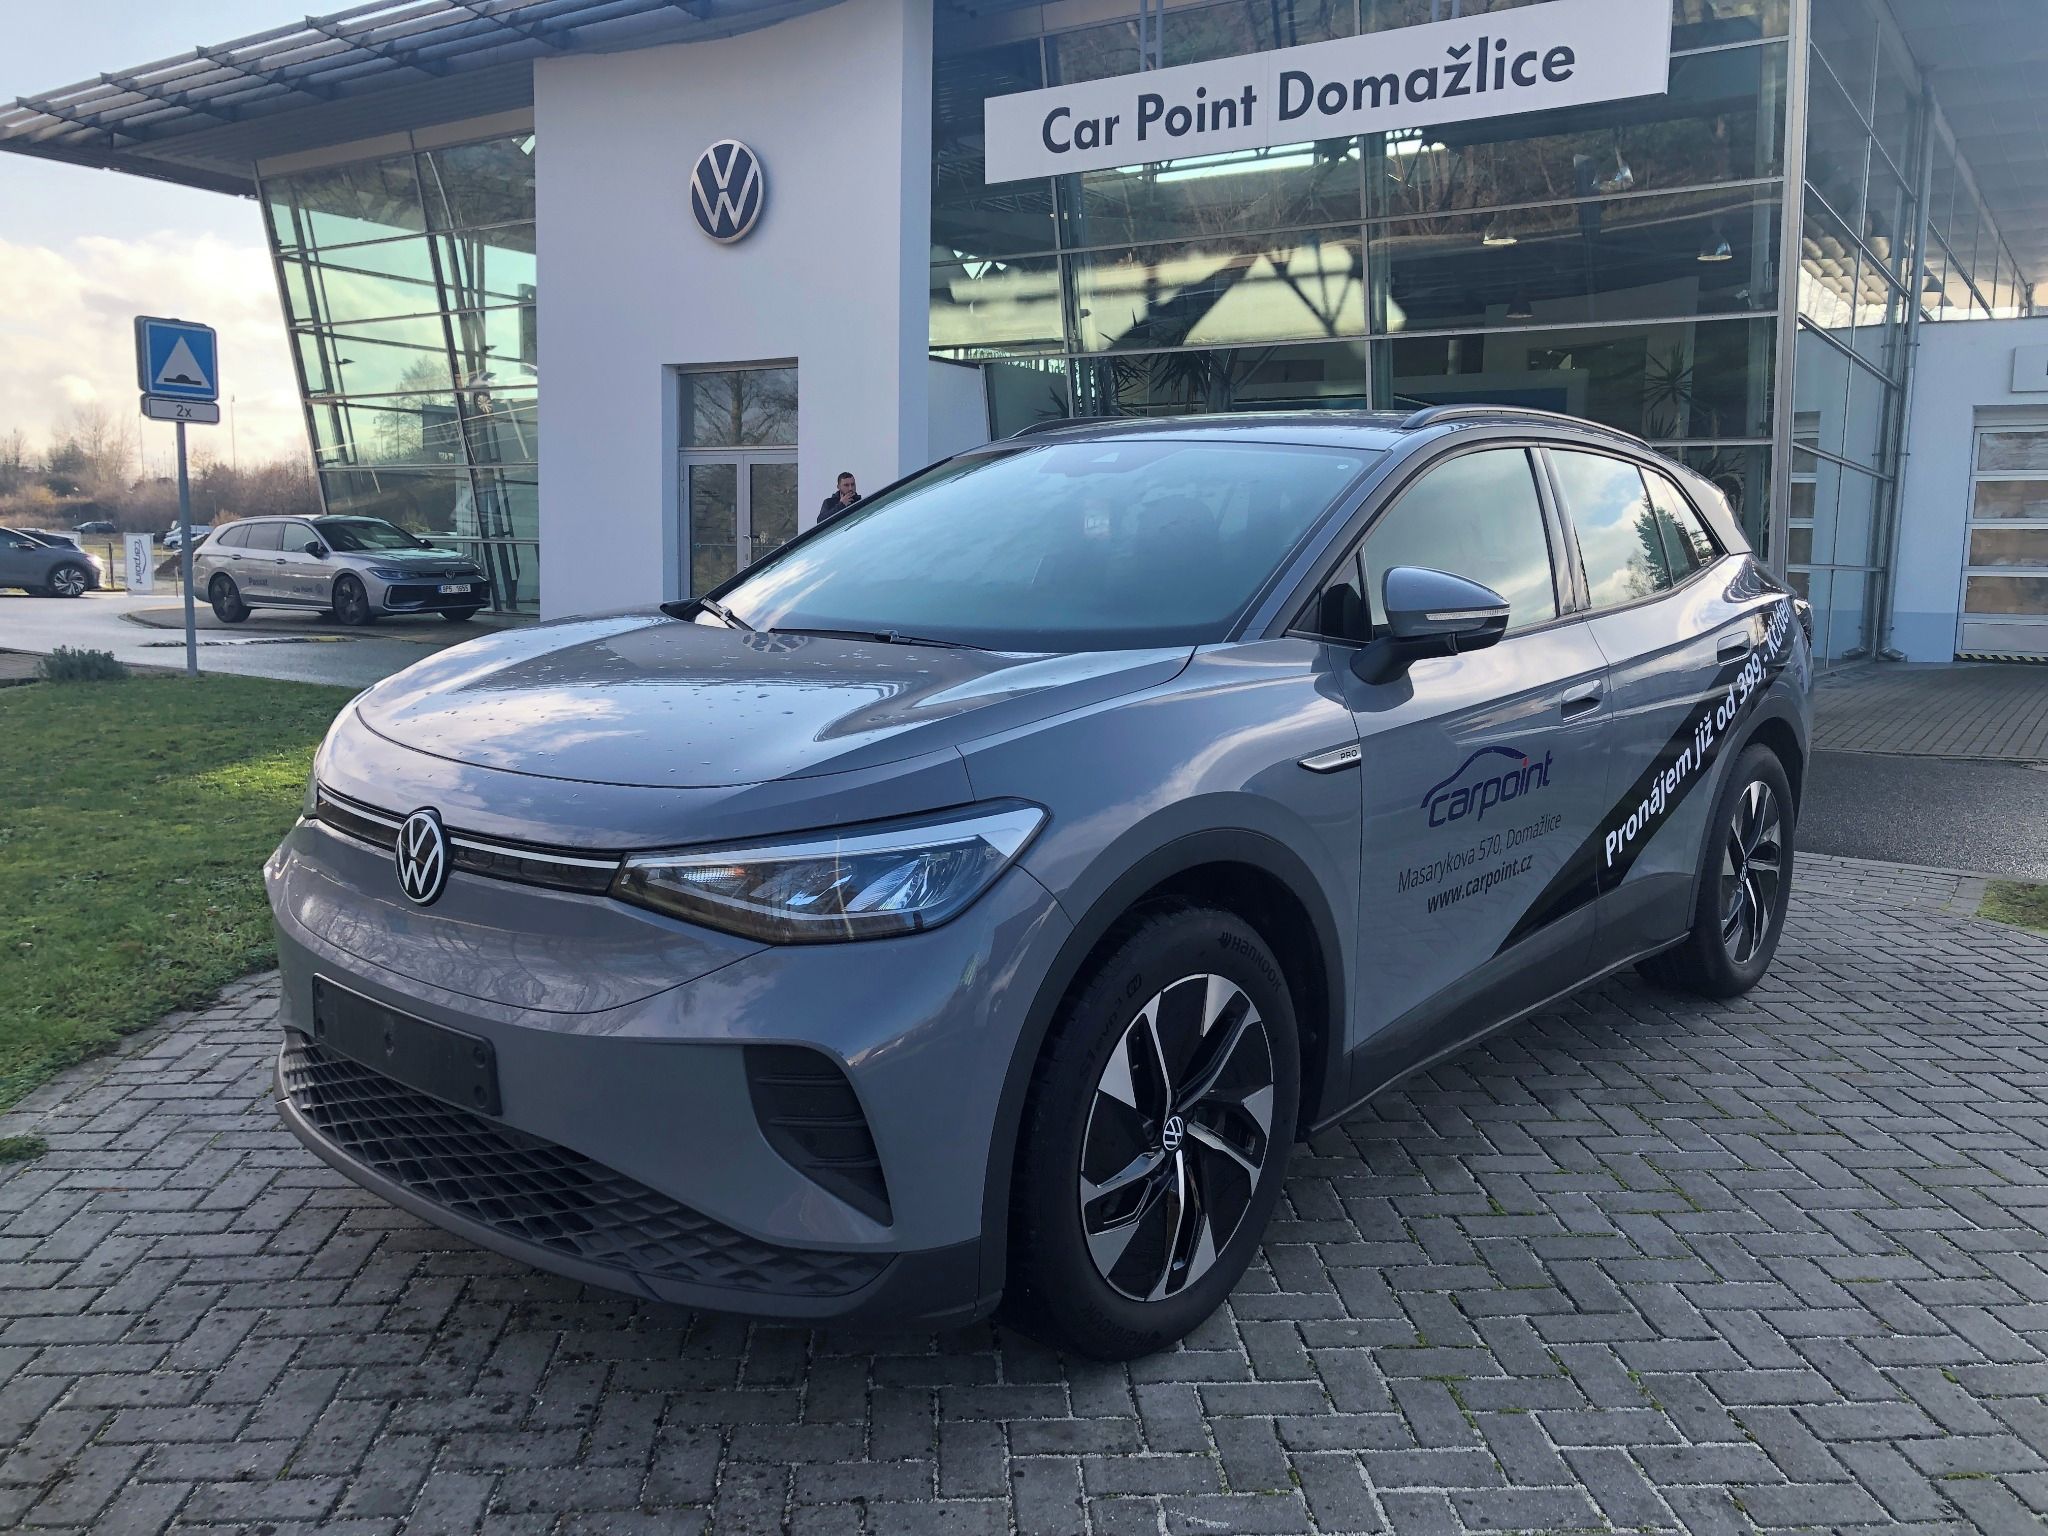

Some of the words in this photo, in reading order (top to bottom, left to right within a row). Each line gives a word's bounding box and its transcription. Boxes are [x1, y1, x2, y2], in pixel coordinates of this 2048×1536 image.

[1042, 106, 1120, 154] Car
[1137, 85, 1257, 142] Point
[1278, 36, 1576, 121] Domažlice
[176, 404, 192, 418] 2x
[1340, 749, 1358, 760] PRO
[1428, 749, 1553, 828] carpoint
[1605, 747, 1692, 868] Pronájem
[1694, 711, 1714, 770] již
[1716, 683, 1736, 731] od
[1398, 848, 1475, 894] Masarykova
[1477, 833, 1503, 861] 570,
[1506, 813, 1562, 850] Domažlice
[1427, 854, 1533, 914] www.carpoint.cz
